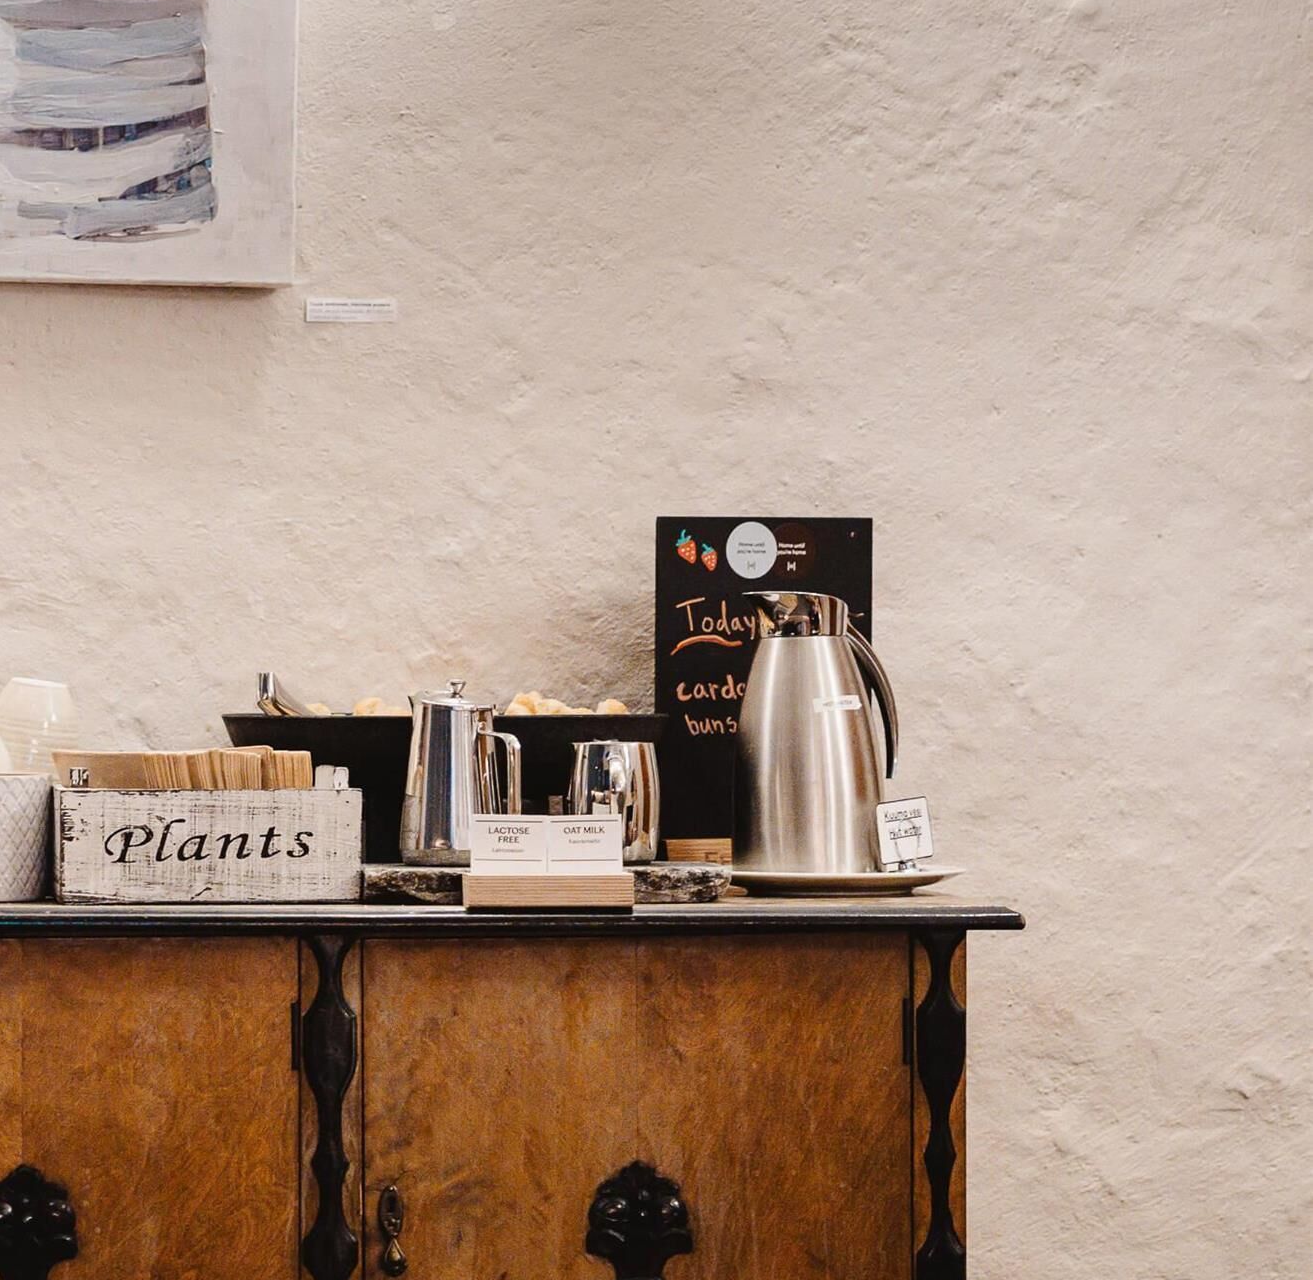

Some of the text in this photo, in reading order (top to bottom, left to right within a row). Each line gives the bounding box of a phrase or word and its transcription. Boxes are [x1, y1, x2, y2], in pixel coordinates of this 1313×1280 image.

[684, 714, 737, 736] buns
[488, 826, 530, 835] LACTOSE
[563, 825, 606, 835] OAT MILK
[104, 818, 314, 864] Plants
[497, 835, 520, 844] FREE
